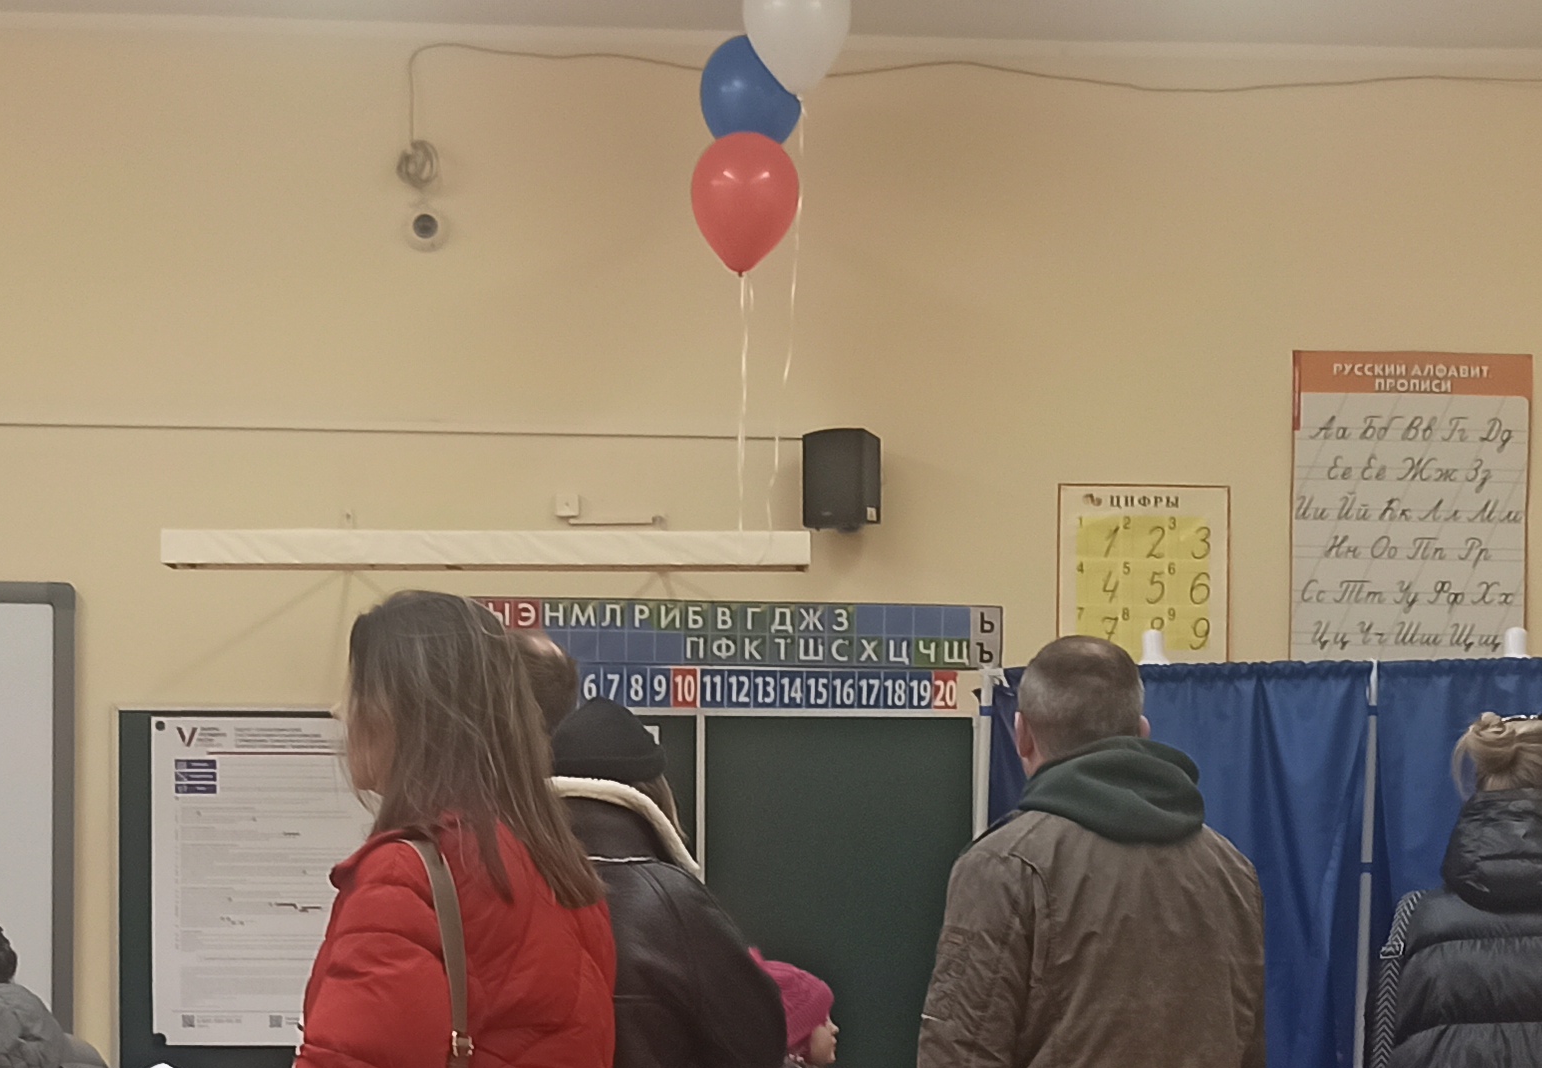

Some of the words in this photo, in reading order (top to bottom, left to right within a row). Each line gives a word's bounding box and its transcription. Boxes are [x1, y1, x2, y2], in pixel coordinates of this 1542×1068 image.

[1411, 364, 1490, 378] АЛФАВИТ
[1375, 379, 1452, 393] ПРОПИСИ
[1110, 495, 1180, 509] ЦИФРЫ
[1078, 516, 1084, 527] 1
[1123, 516, 1131, 530] 2
[1168, 516, 1176, 530] 3
[1104, 525, 1120, 558] 1
[1146, 526, 1165, 559] 2
[1191, 526, 1211, 559] 3
[1076, 562, 1084, 574] 4
[1123, 562, 1131, 575] 5
[1168, 562, 1176, 575] 6
[1102, 571, 1120, 603] 4
[1145, 571, 1165, 604] 5
[1190, 572, 1210, 605] 6
[517, 602, 536, 627] Э
[544, 603, 564, 627] Н
[570, 604, 597, 627] М
[601, 604, 621, 627] Л
[634, 604, 650, 627] Р
[660, 603, 680, 629] Й
[688, 606, 704, 629] Б
[717, 607, 732, 629] В
[747, 607, 762, 630] Г
[770, 607, 794, 633] Д
[799, 608, 824, 631] Ж
[832, 608, 849, 631] З
[980, 611, 995, 633] Ь
[1077, 606, 1085, 620] 7
[1122, 607, 1130, 621] 8
[1168, 607, 1176, 621] 9
[1189, 617, 1210, 650] 9
[685, 637, 705, 659] П
[712, 637, 736, 659] Ф
[744, 638, 762, 660] К
[775, 638, 792, 660] Т
[799, 639, 824, 661] Ш
[831, 639, 849, 661] С
[859, 639, 879, 662] Х
[889, 640, 909, 665] Ц
[918, 640, 936, 662] Ч
[944, 641, 970, 665] Щ
[976, 642, 994, 664] Ъ
[583, 674, 597, 700] 6
[607, 674, 620, 700] 7
[630, 674, 644, 701] 8
[653, 675, 667, 701] 9
[674, 675, 695, 702] 10
[703, 675, 722, 702] 11
[728, 676, 750, 703] 12
[755, 676, 775, 703] 13
[781, 677, 803, 704] 14
[807, 678, 827, 705] 15
[833, 678, 854, 705] 16
[859, 679, 880, 706] 17
[884, 679, 905, 706] 18
[910, 680, 931, 706] 19
[934, 680, 957, 707] 20
